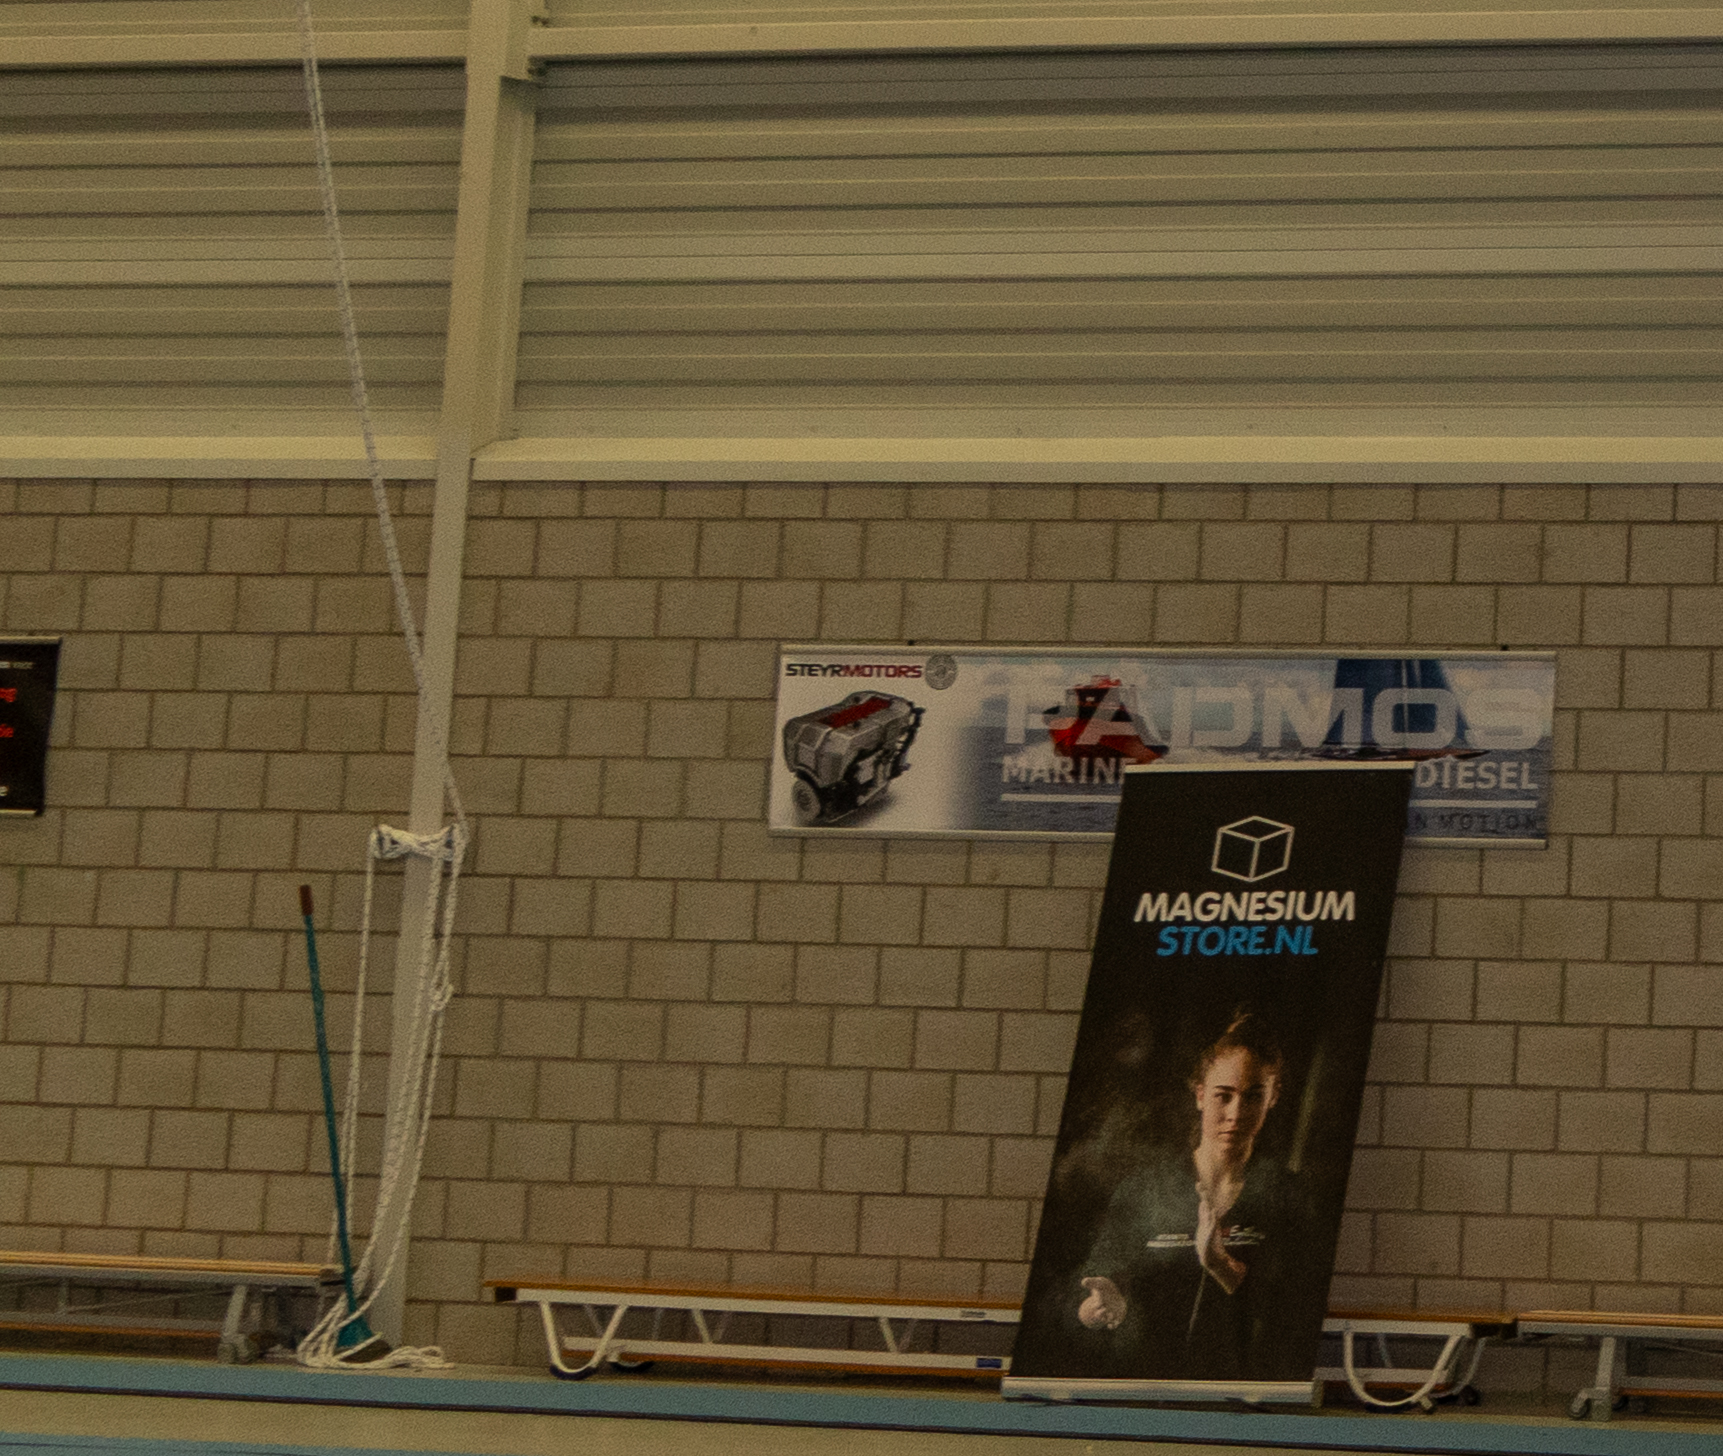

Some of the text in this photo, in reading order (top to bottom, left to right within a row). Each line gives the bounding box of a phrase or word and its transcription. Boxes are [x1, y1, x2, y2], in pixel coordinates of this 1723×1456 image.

[1004, 685, 1545, 751] PADMOS
[1415, 760, 1539, 790] DIESEL
[1133, 890, 1356, 923] MAGNESIUM
[1156, 925, 1319, 956] STORE.NL
